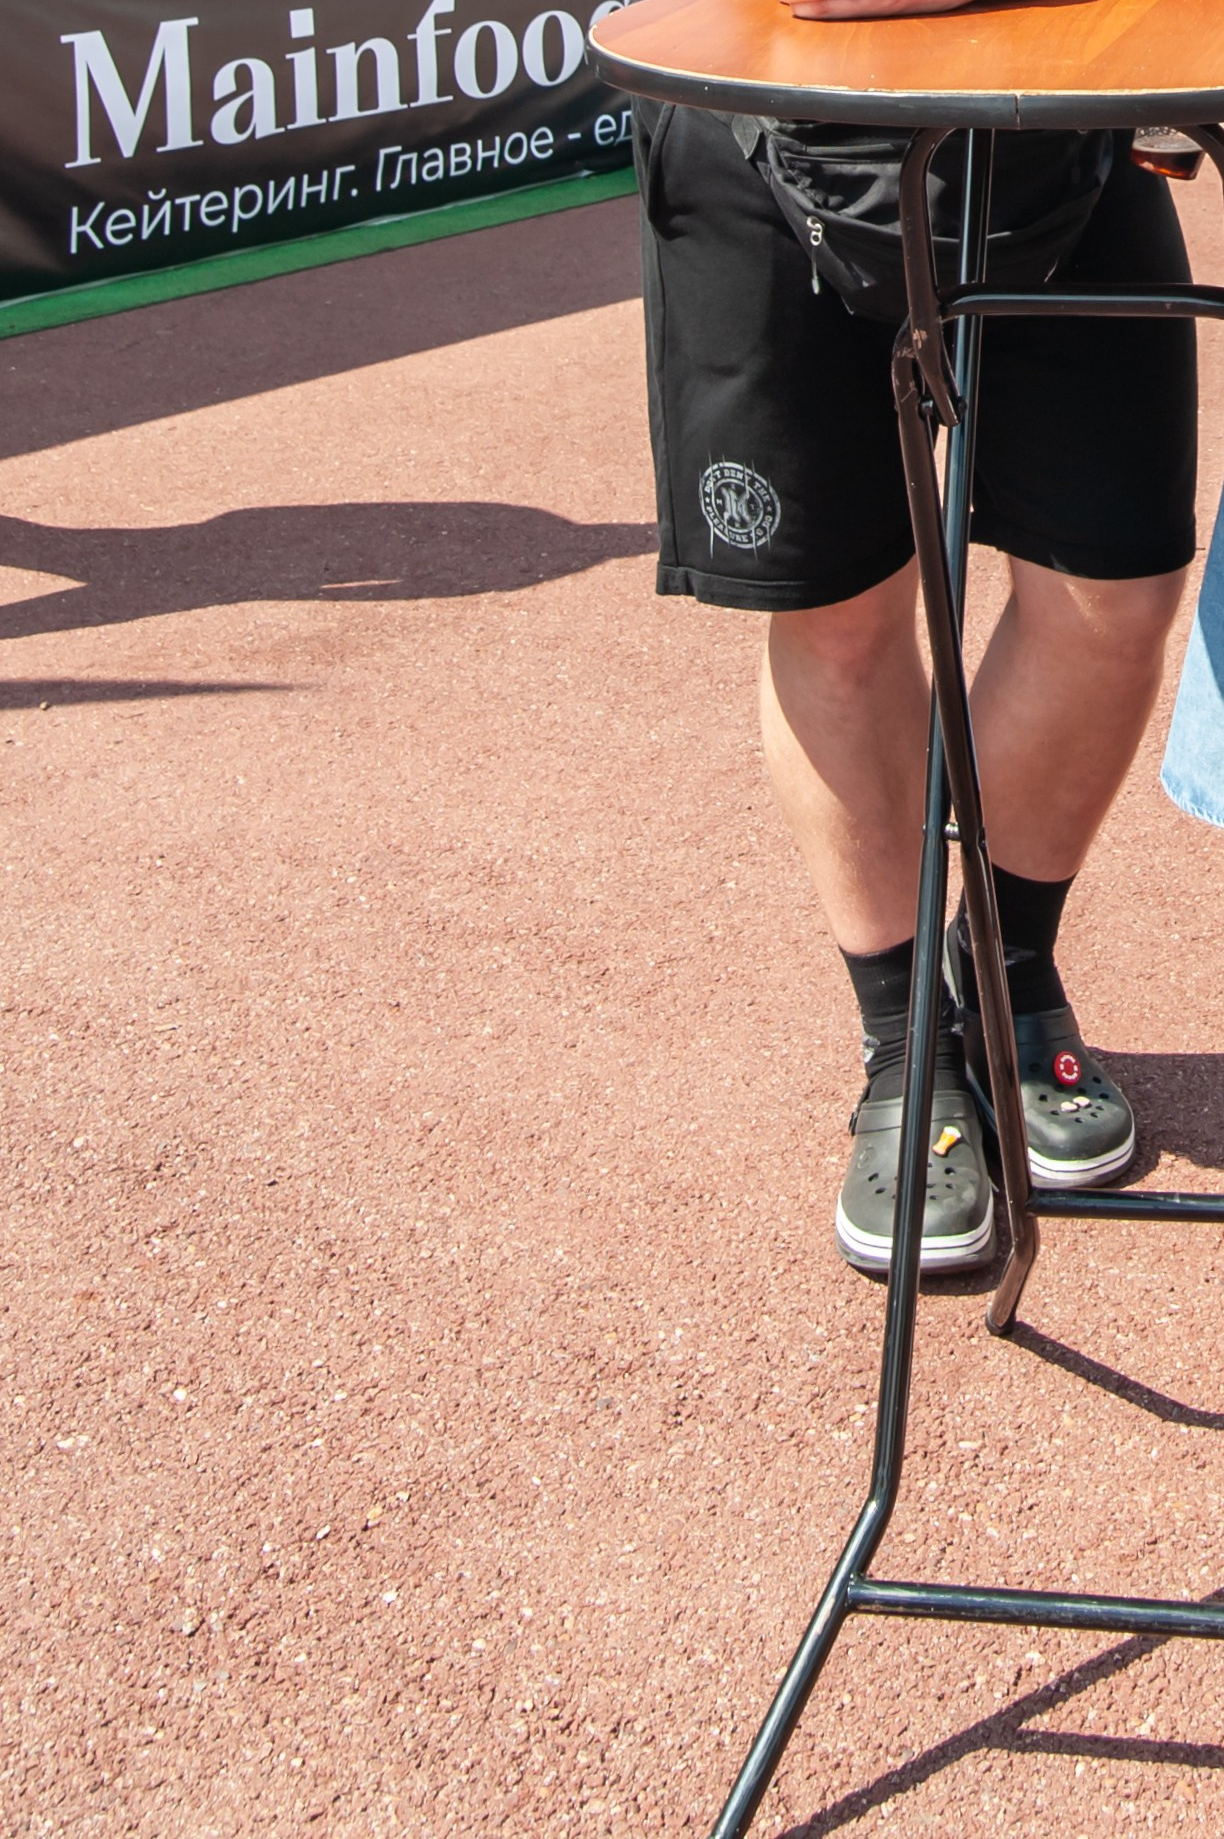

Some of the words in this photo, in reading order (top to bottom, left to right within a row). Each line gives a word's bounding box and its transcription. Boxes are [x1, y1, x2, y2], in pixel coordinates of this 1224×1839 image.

[70, 164, 359, 253] Кейтеринг.
[374, 126, 555, 193] Главное
[706, 506, 749, 542] PLEAURE
